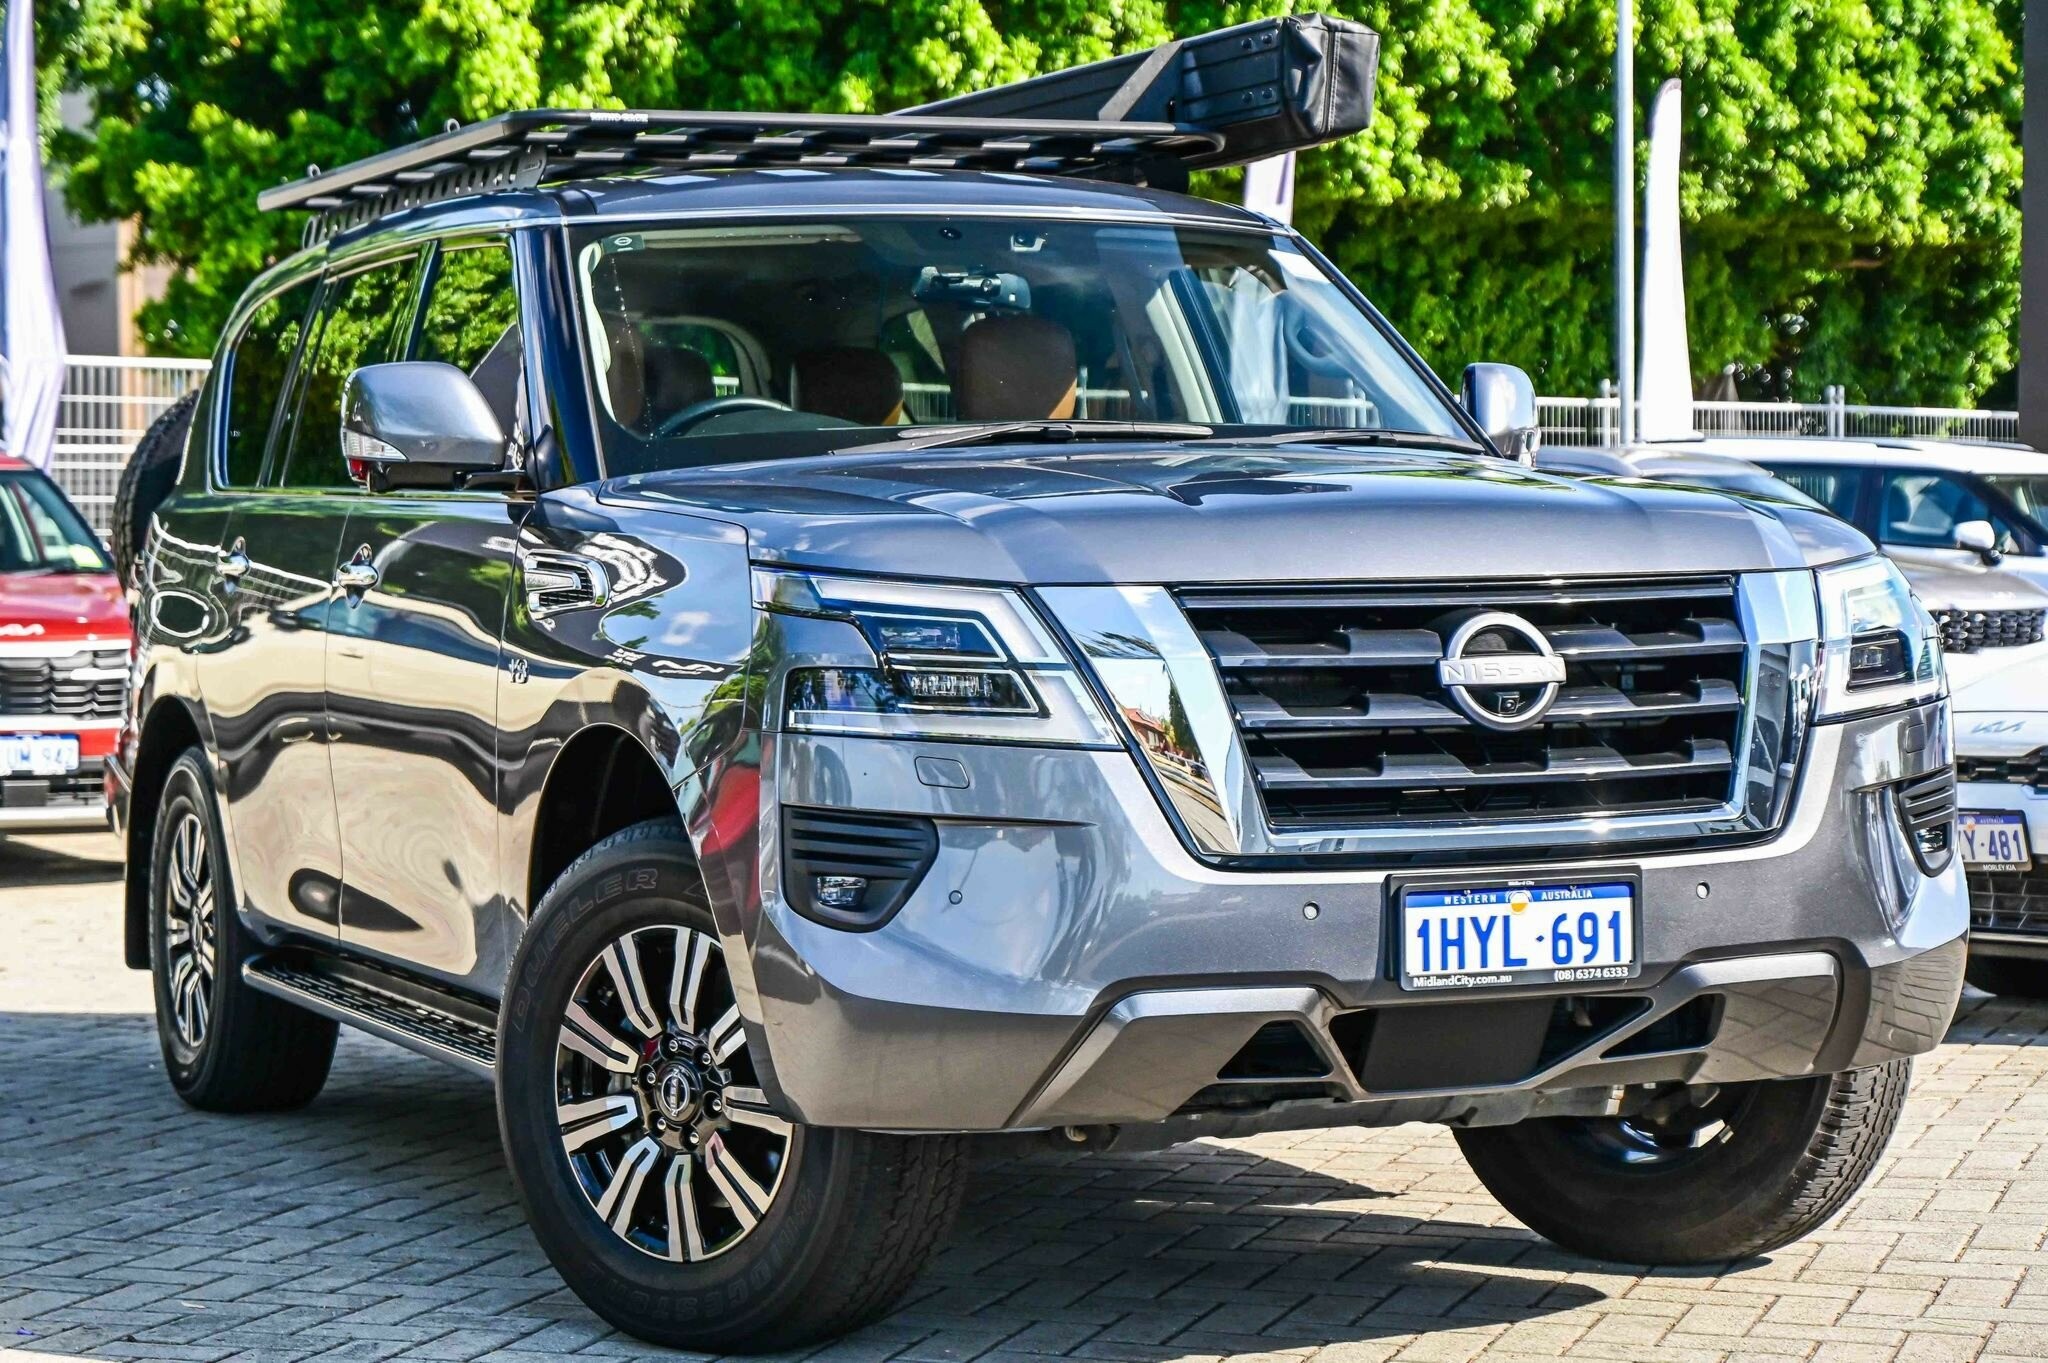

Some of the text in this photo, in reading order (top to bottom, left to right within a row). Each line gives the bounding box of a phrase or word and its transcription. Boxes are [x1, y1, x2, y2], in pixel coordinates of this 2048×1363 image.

[1444, 660, 1562, 683] NISSAN
[1444, 889, 1593, 905] WESTERN AUSTRALIA
[1413, 967, 1629, 988] MidlandCity.com.au (08) 6374 6333
